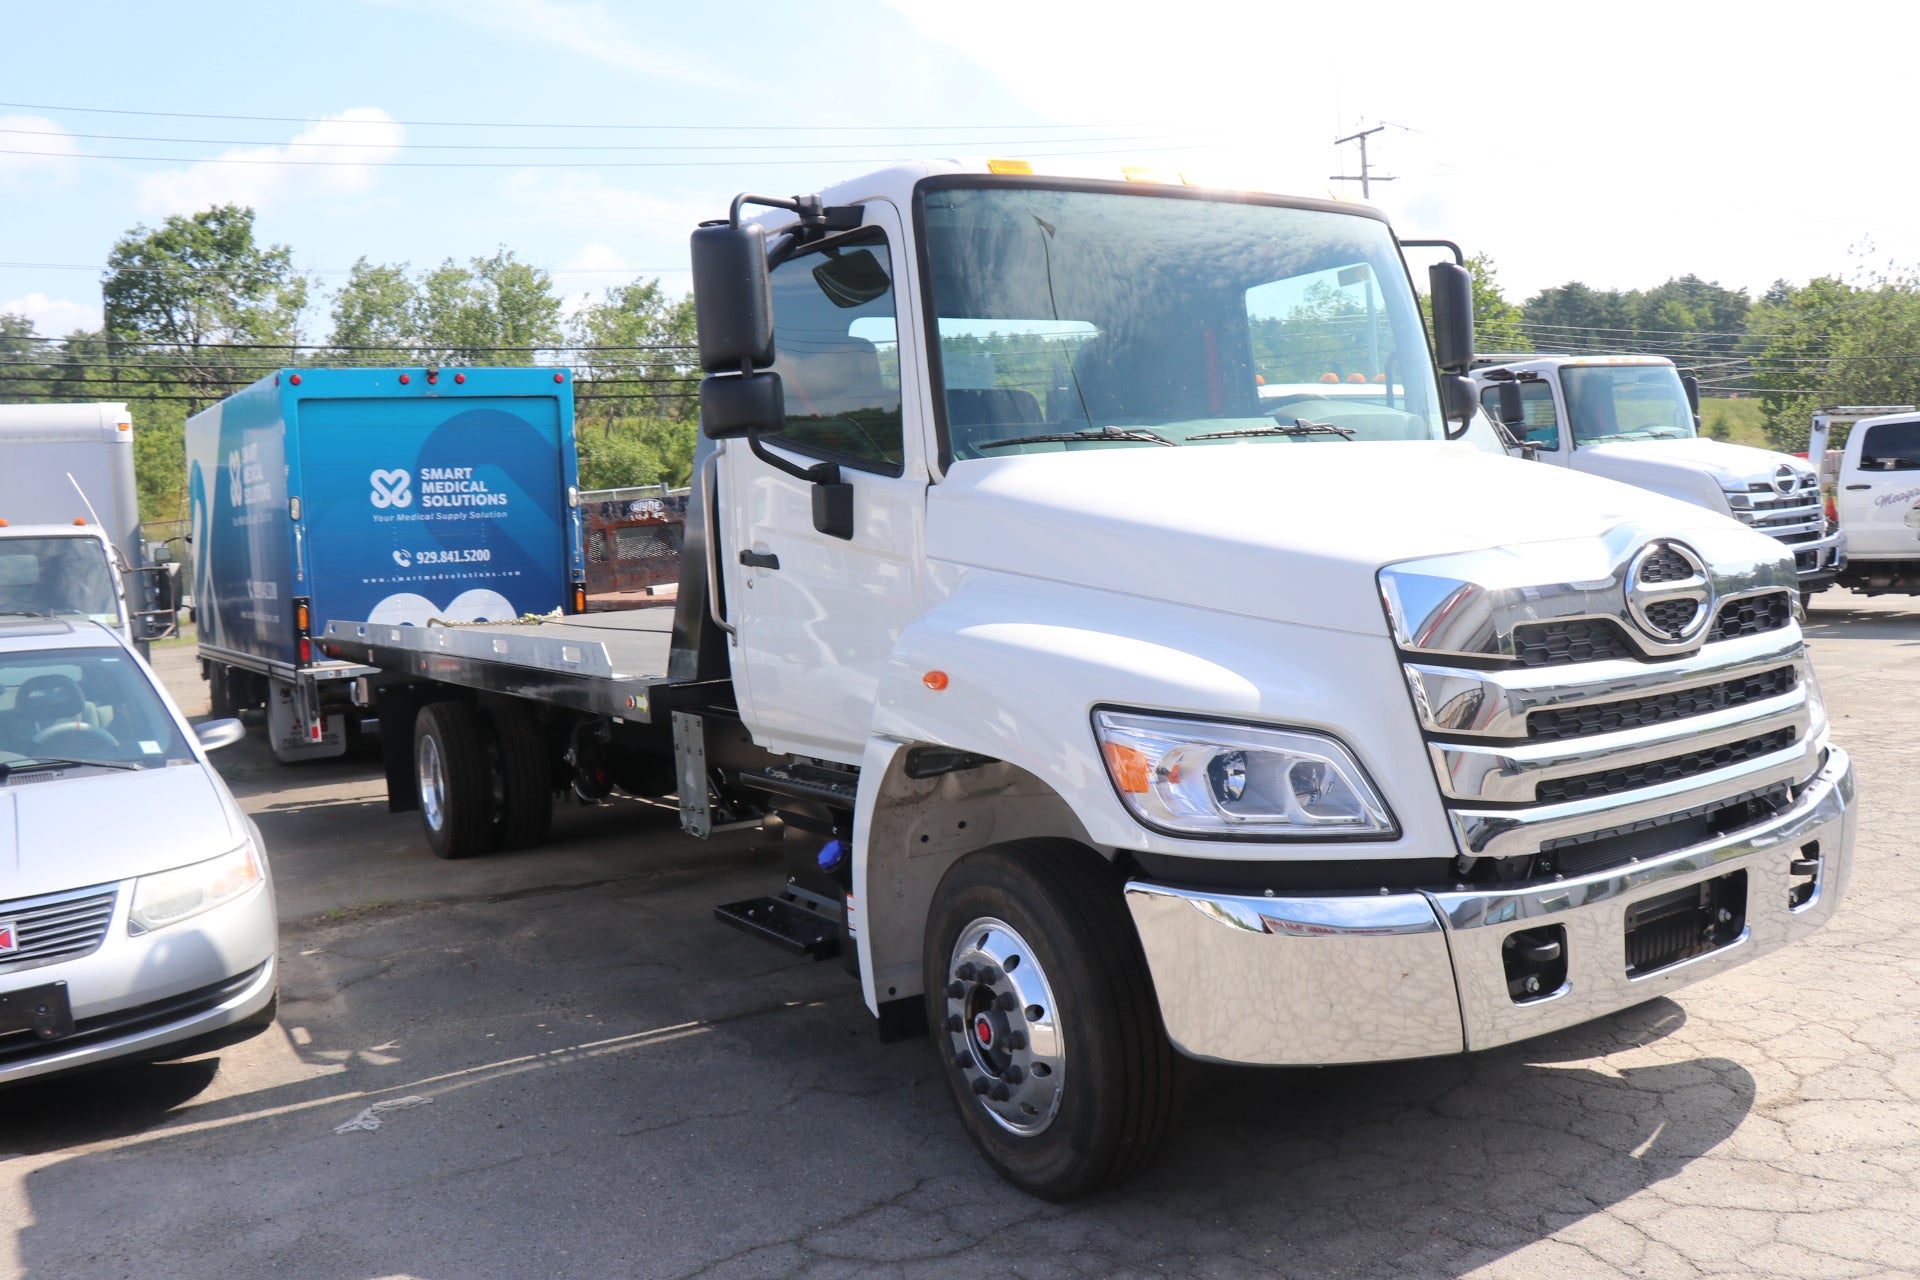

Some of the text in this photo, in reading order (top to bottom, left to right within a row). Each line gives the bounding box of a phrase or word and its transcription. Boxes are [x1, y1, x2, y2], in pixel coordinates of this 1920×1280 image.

[421, 467, 473, 480] SMART
[422, 481, 488, 494] MEDICAL
[422, 494, 507, 508] SOLUTIONS
[373, 510, 508, 523] Your Medical Supply Solution
[416, 549, 491, 564] 929.841.5200
[362, 570, 521, 584] www.smartmedsolutions.com
